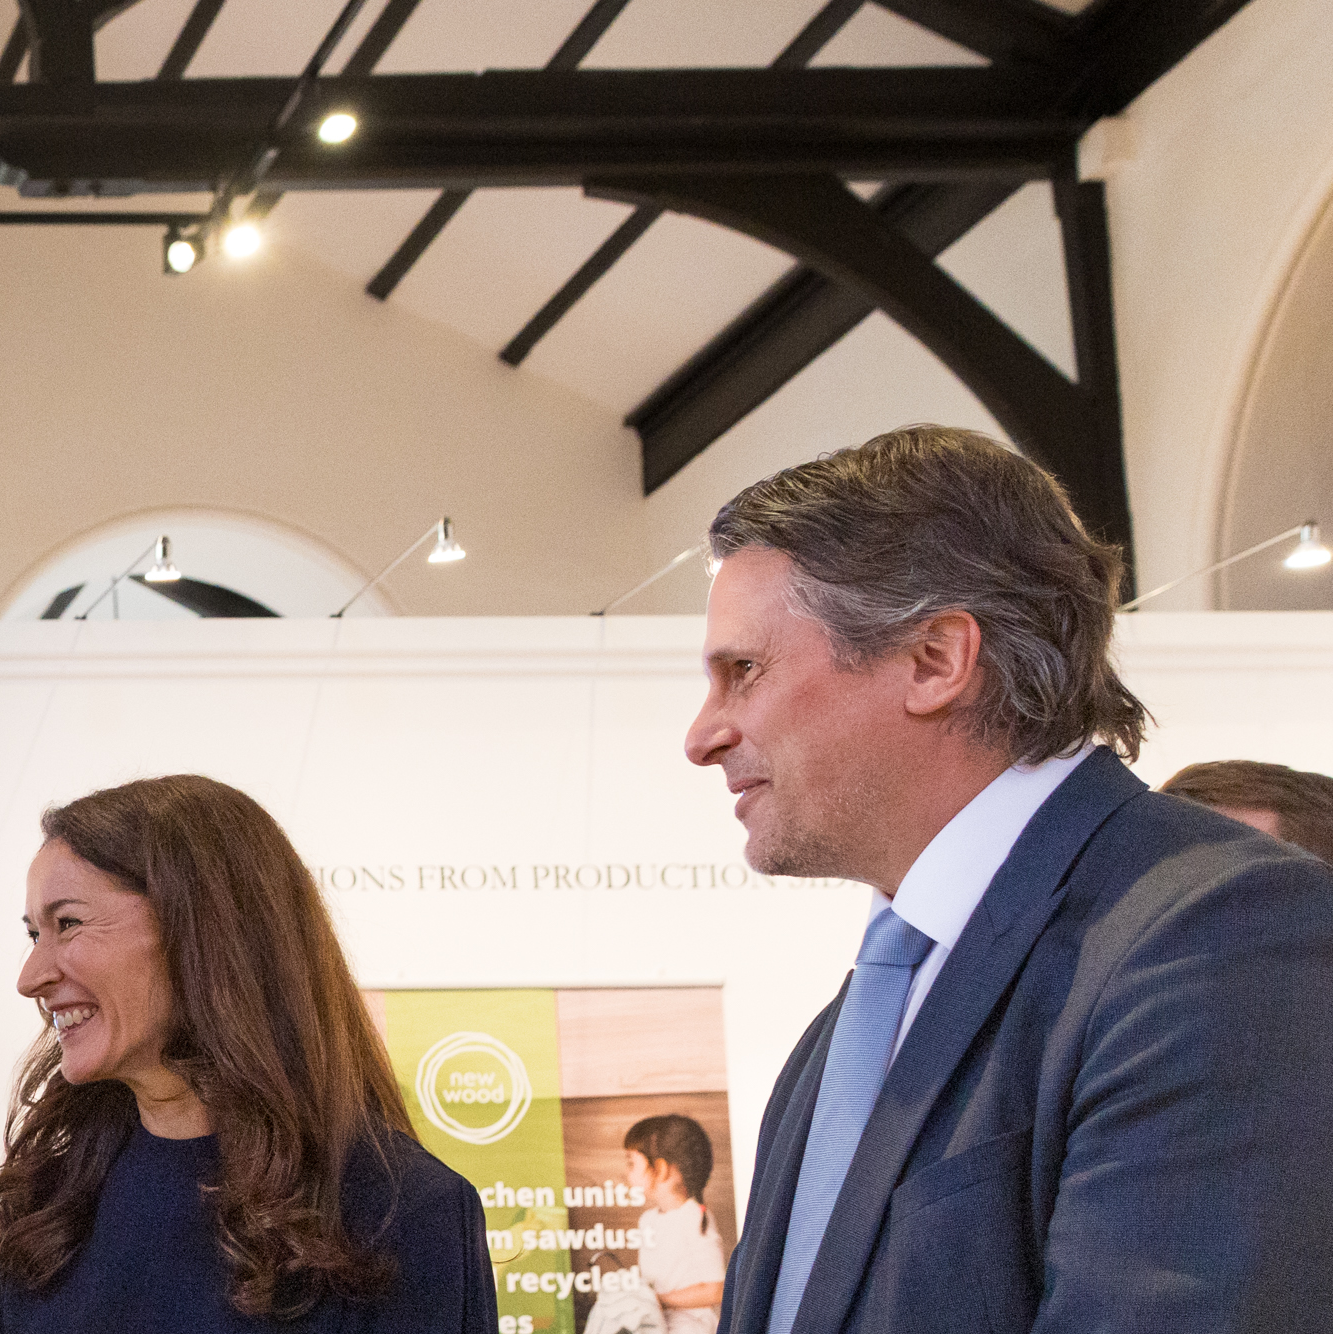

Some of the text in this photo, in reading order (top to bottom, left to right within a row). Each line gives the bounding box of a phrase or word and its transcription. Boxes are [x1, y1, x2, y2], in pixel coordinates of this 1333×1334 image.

[317, 864, 405, 892] IONS
[417, 865, 519, 891] FROM
[442, 1082, 505, 1105] wood
[449, 1071, 496, 1088] new
[563, 1179, 646, 1208] units
[521, 1222, 656, 1251] sawdust
[505, 1264, 641, 1300] recycled
